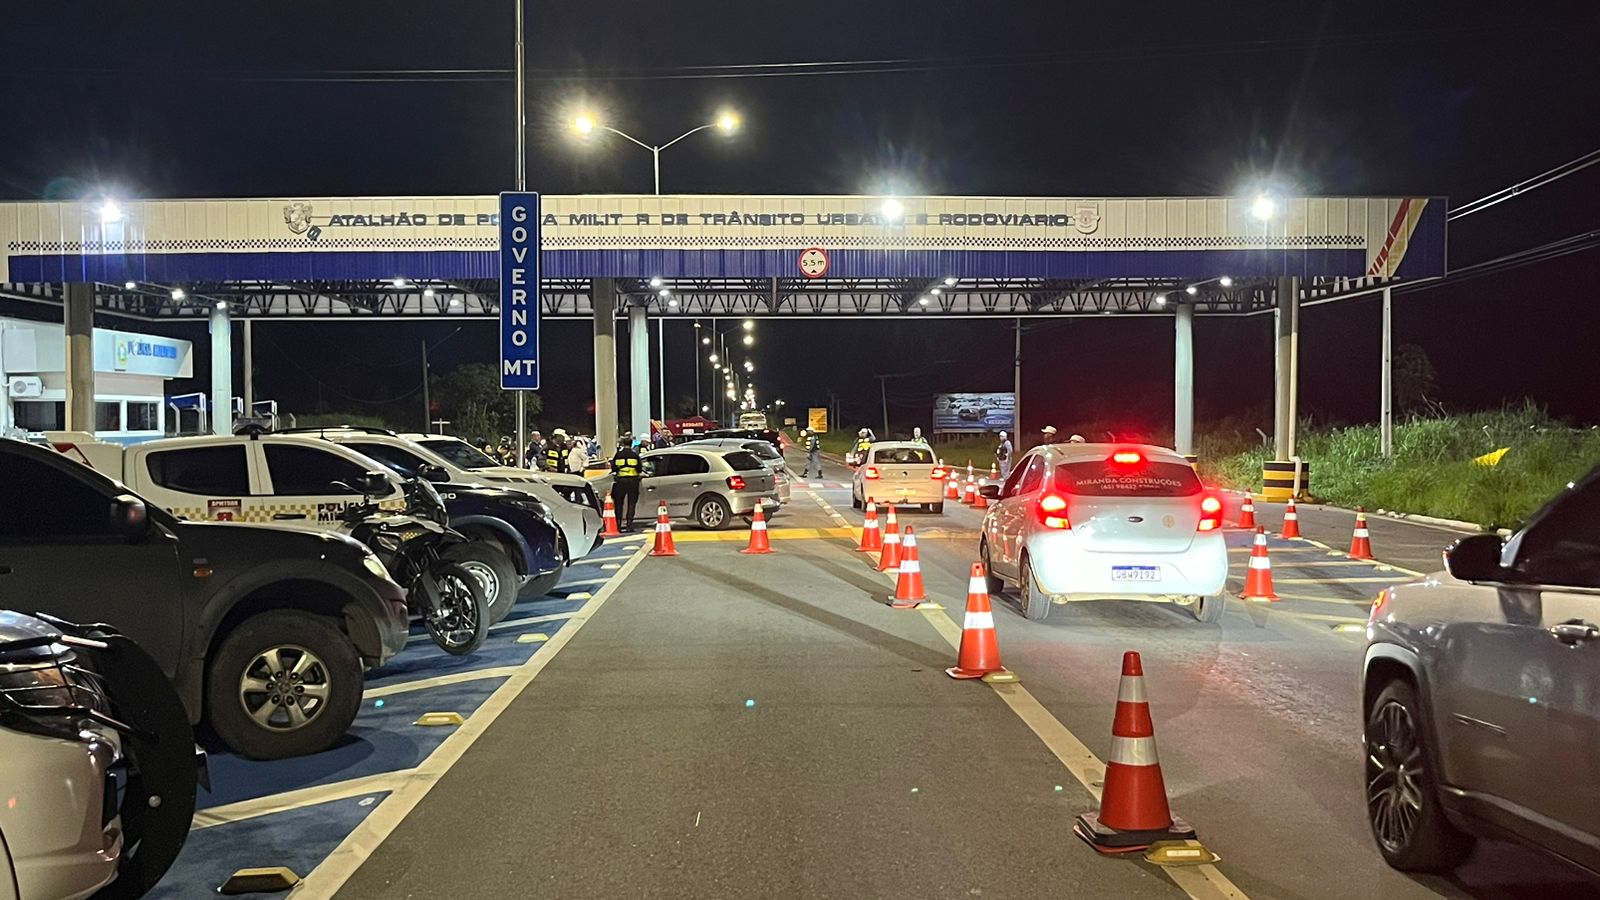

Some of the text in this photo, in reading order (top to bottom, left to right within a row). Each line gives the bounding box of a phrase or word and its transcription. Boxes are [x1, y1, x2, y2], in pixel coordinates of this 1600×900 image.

[438, 214, 466, 226] DE
[661, 213, 689, 226] DE
[699, 211, 805, 226] TRÂNSITO
[817, 213, 905, 226] URBA
[511, 206, 528, 346] GOVERNO
[504, 359, 536, 376] MT
[1076, 478, 1118, 486] MIRANDA
